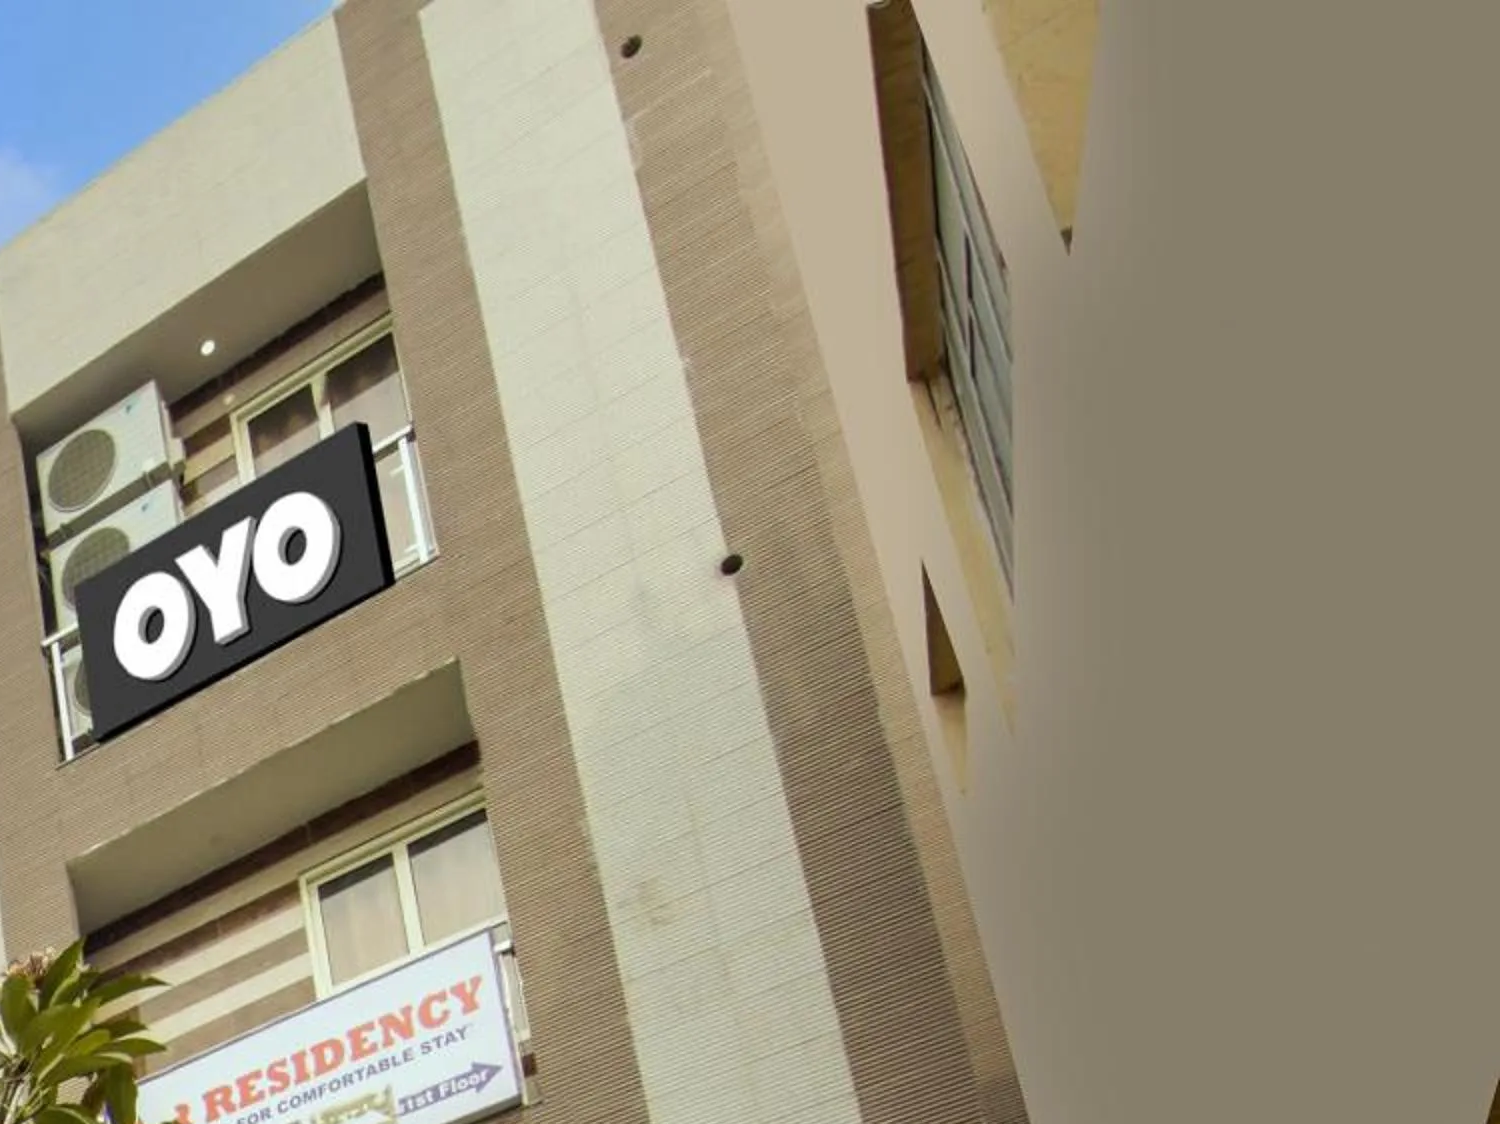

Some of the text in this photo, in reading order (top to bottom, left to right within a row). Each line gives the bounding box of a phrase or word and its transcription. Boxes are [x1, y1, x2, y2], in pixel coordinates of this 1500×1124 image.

[113, 492, 339, 682] OYO
[202, 976, 483, 1122] RESIDENCY
[277, 1047, 414, 1114] COMFORTABLE
[419, 1026, 469, 1055] STAY
[439, 1068, 487, 1098] Floor
